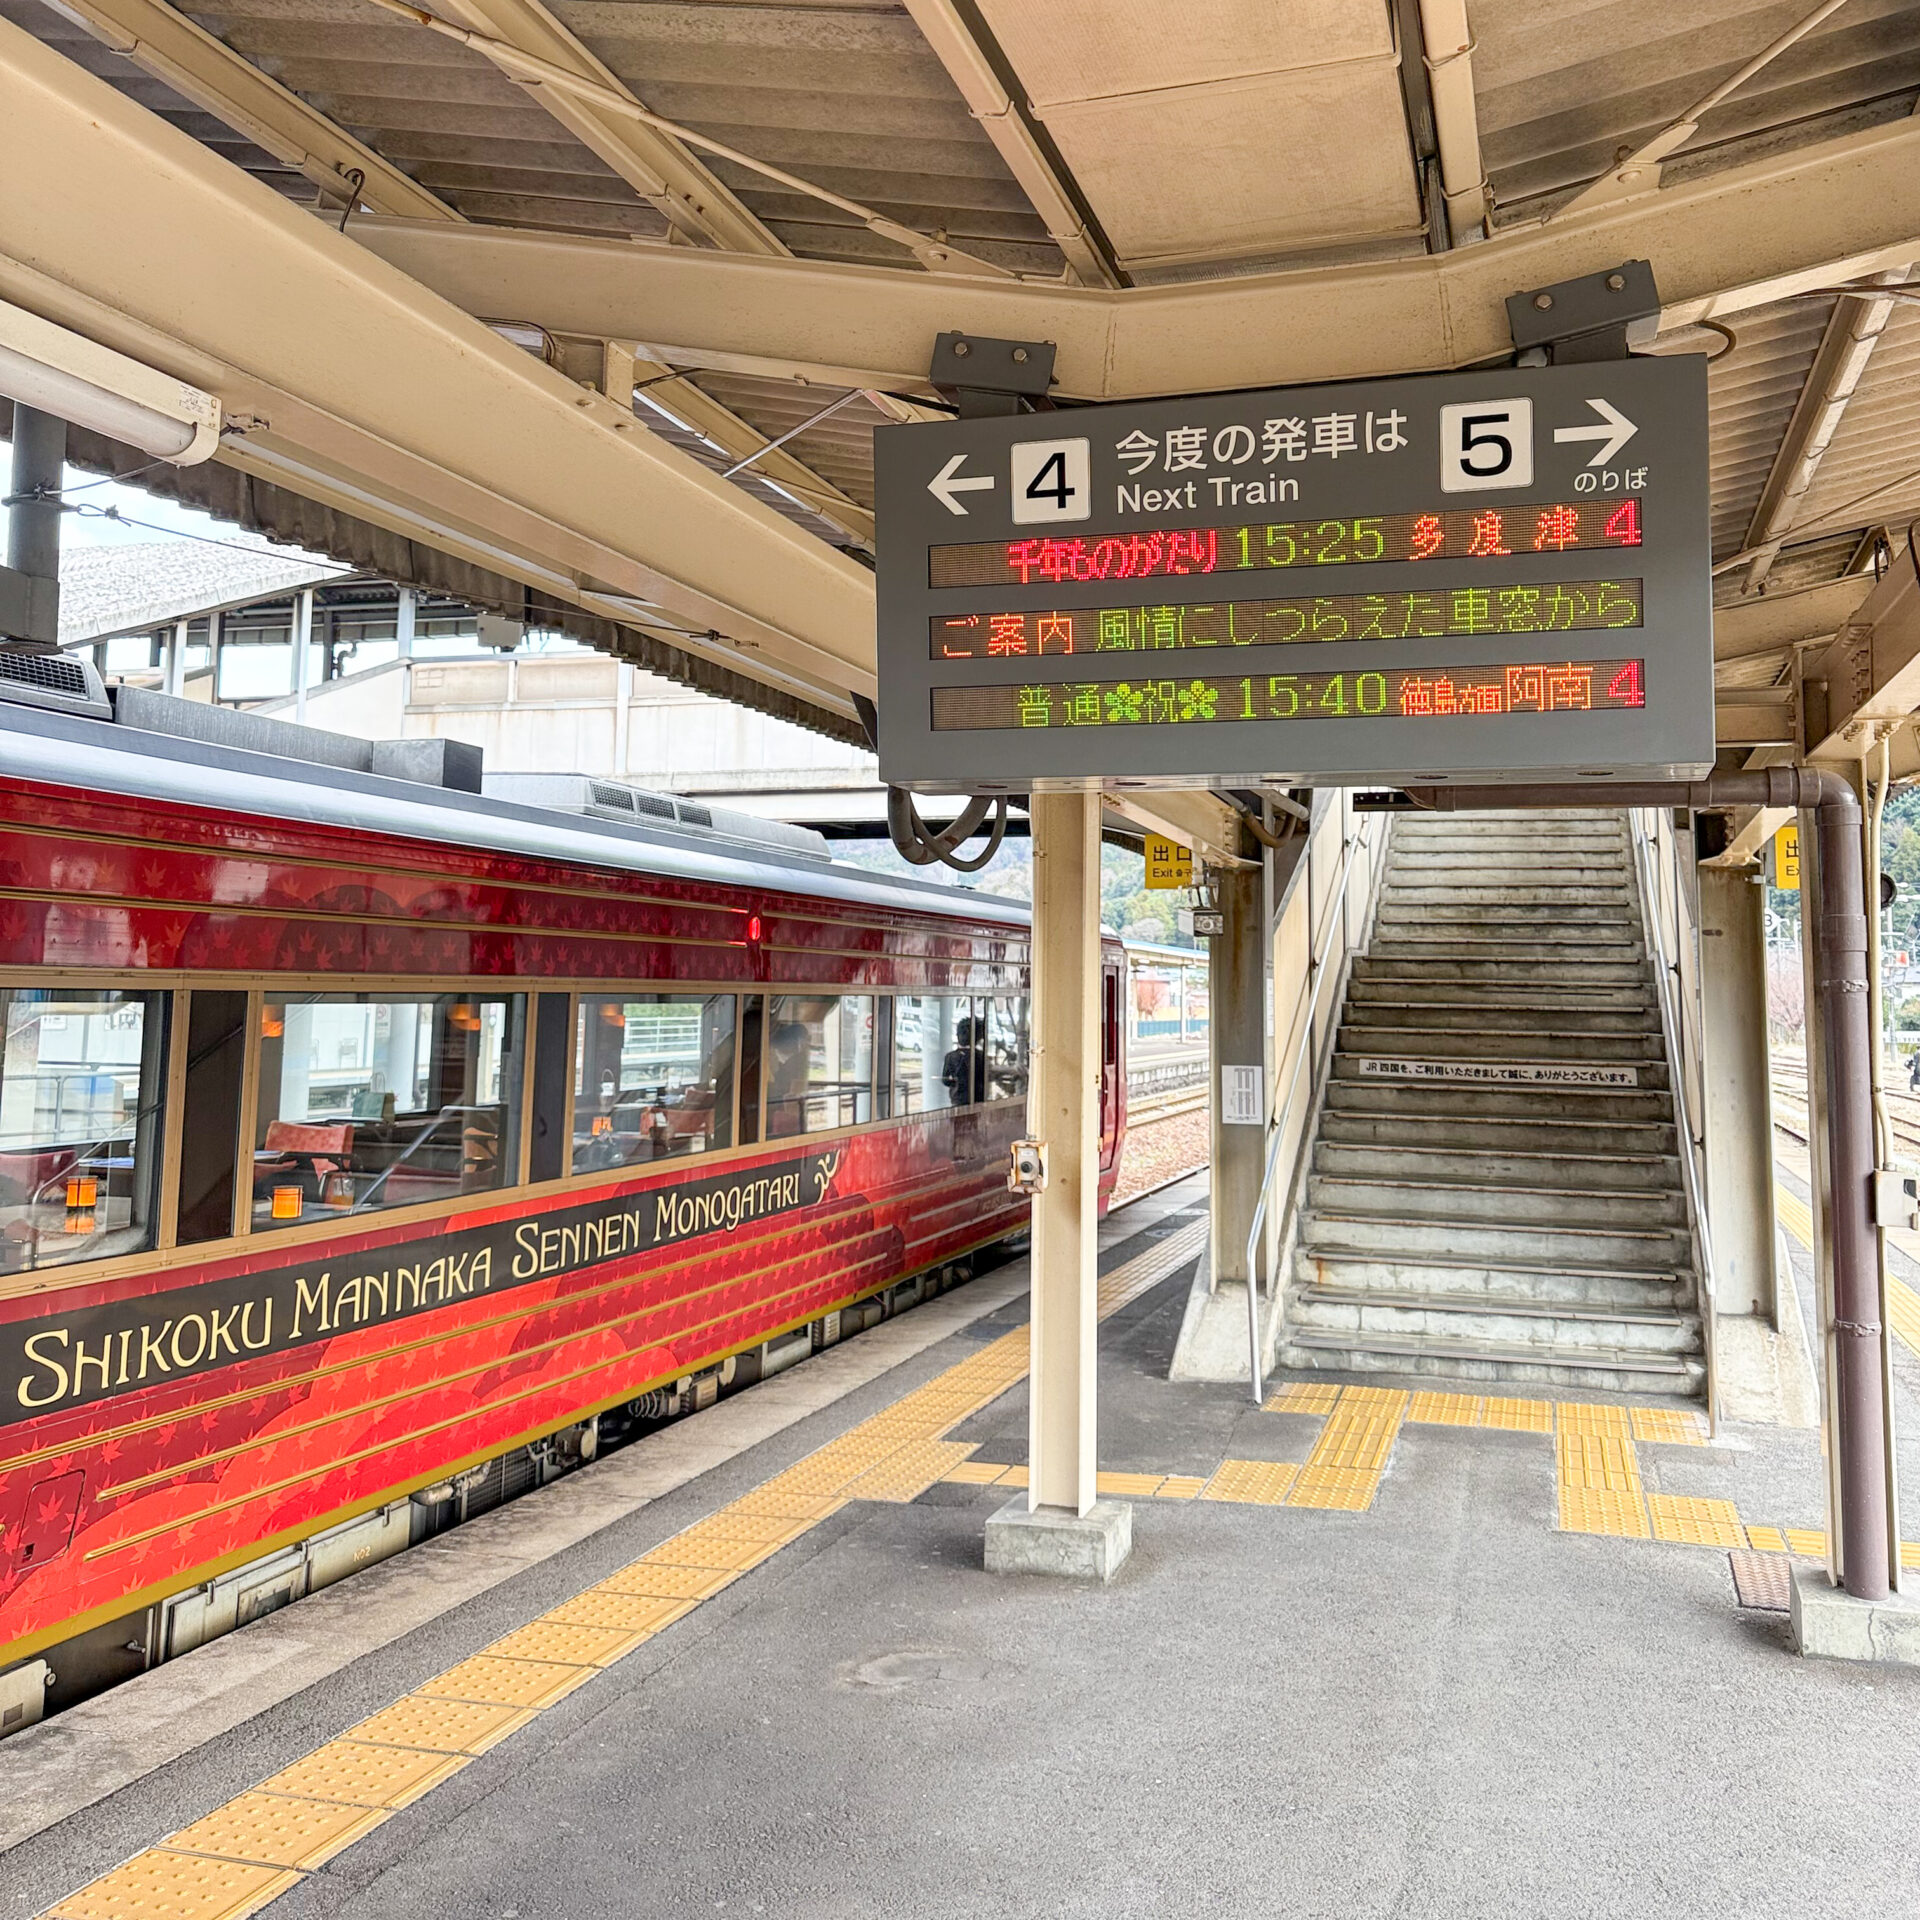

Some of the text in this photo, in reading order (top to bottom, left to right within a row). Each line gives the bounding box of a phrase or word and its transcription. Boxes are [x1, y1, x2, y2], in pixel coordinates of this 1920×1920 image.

[1115, 408, 1408, 476] 今度の発車は
[1459, 412, 1513, 478] 5
[1025, 451, 1076, 510] 4
[1116, 474, 1300, 514] Next Train
[1574, 466, 1649, 493] のりば
[1008, 528, 1217, 584] 千年ものがたり
[1236, 518, 1385, 568] 15:25
[1605, 499, 1643, 545] 4
[943, 582, 1638, 657] ご案内 風情にしつらえた車窓から
[1239, 672, 1387, 719] 15:40
[1608, 661, 1646, 707] 4
[1152, 867, 1173, 878] Exit
[1153, 844, 1193, 862] 出口
[16, 1296, 273, 1408] SHIKOKU
[289, 1246, 492, 1340] MANNAKA
[511, 1210, 642, 1280] SENNEN
